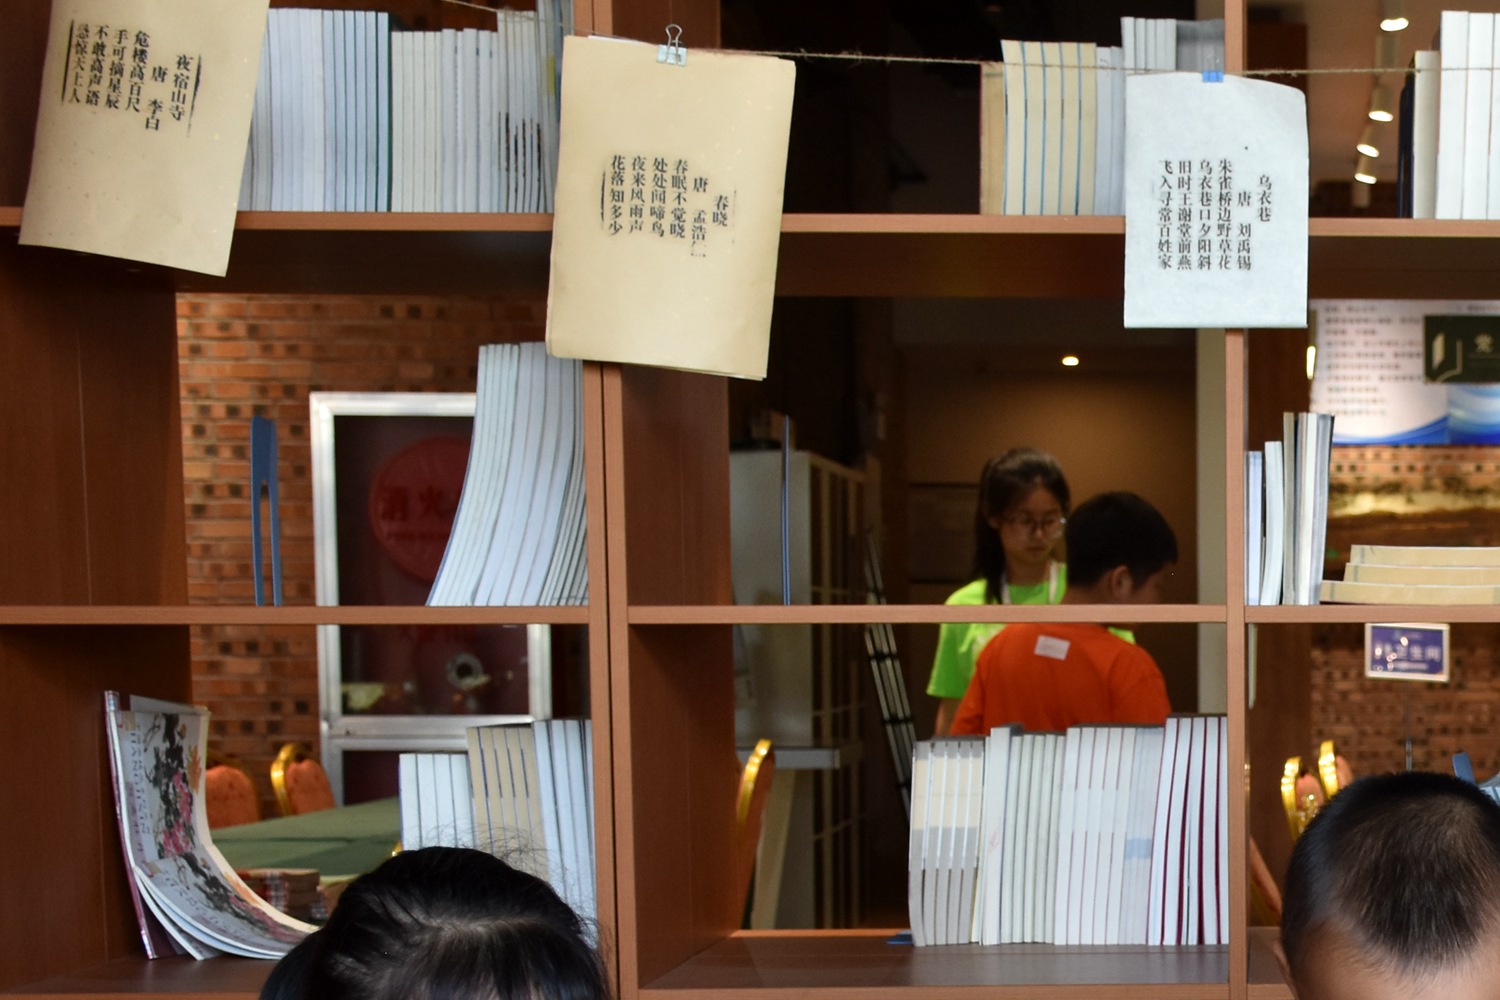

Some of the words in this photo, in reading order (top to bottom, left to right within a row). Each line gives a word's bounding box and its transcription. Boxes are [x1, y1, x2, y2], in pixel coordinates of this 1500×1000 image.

[85, 24, 109, 106] 不敢高声语
[105, 29, 129, 110] 手可摘星辰
[125, 30, 151, 113] 危楼高百尺
[152, 66, 168, 83] 唐
[169, 54, 194, 121] 夜宿山寺
[145, 99, 163, 131] 李白
[608, 155, 626, 236] 花落知多少
[628, 155, 647, 234] 夜来风雨声
[650, 157, 668, 238] 处处闻啼鸟
[670, 158, 688, 239] 春眠不觉晓
[693, 177, 708, 193] 唐
[712, 195, 729, 227] 春晓
[1158, 160, 1173, 270] 飞入寻常百姓家
[1177, 160, 1192, 270] 旧时王谢堂前燕
[1197, 159, 1212, 270] 乌衣巷口夕阳斜
[1216, 158, 1232, 270] 朱雀桥边野草花
[1237, 190, 1251, 207] 唐
[1257, 174, 1272, 222] 乌衣巷
[691, 209, 707, 258] 孟浩
[1237, 223, 1251, 271] 刘禹锡
